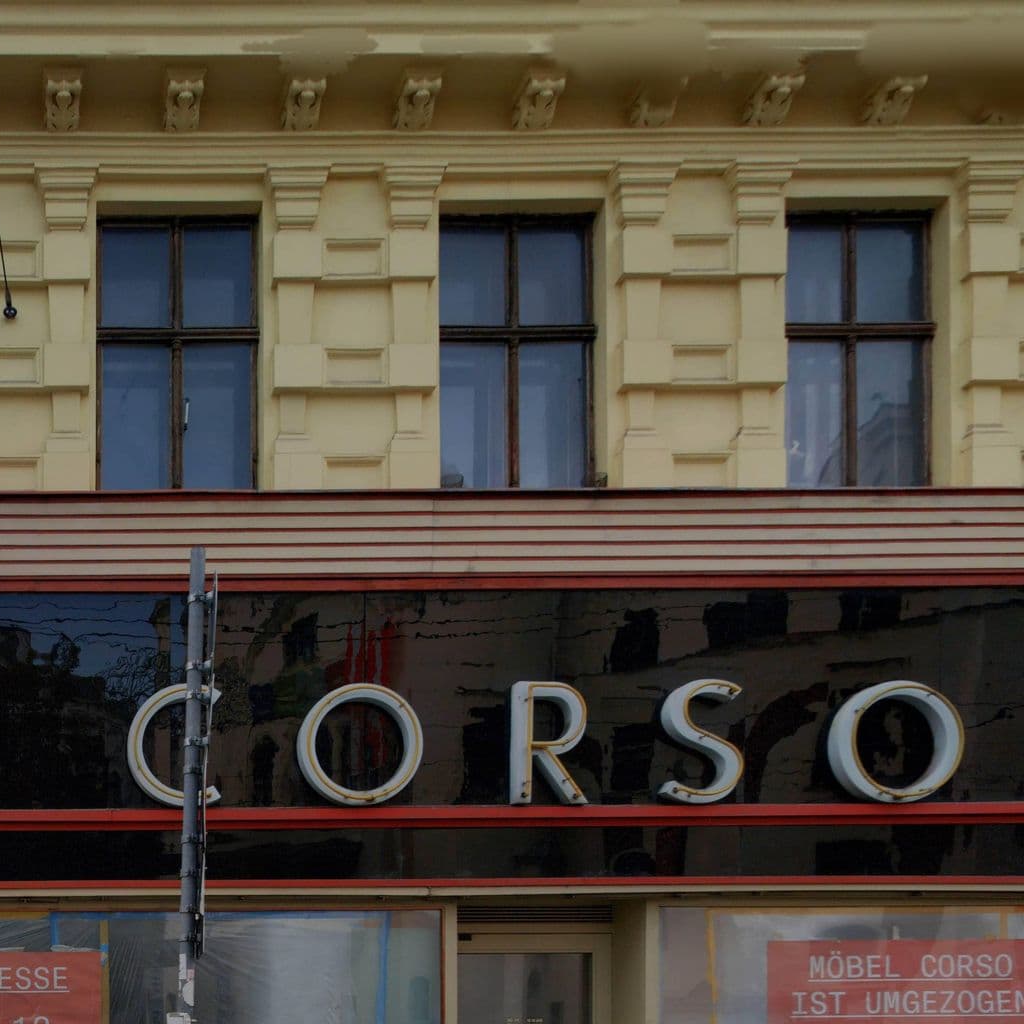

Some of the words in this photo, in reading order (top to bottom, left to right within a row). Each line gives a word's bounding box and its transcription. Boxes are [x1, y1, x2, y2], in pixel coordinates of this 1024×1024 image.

[127, 680, 965, 804] CORSO
[809, 950, 900, 979] MÖBEL
[921, 953, 1013, 978] CORSO
[792, 991, 846, 1015] IST
